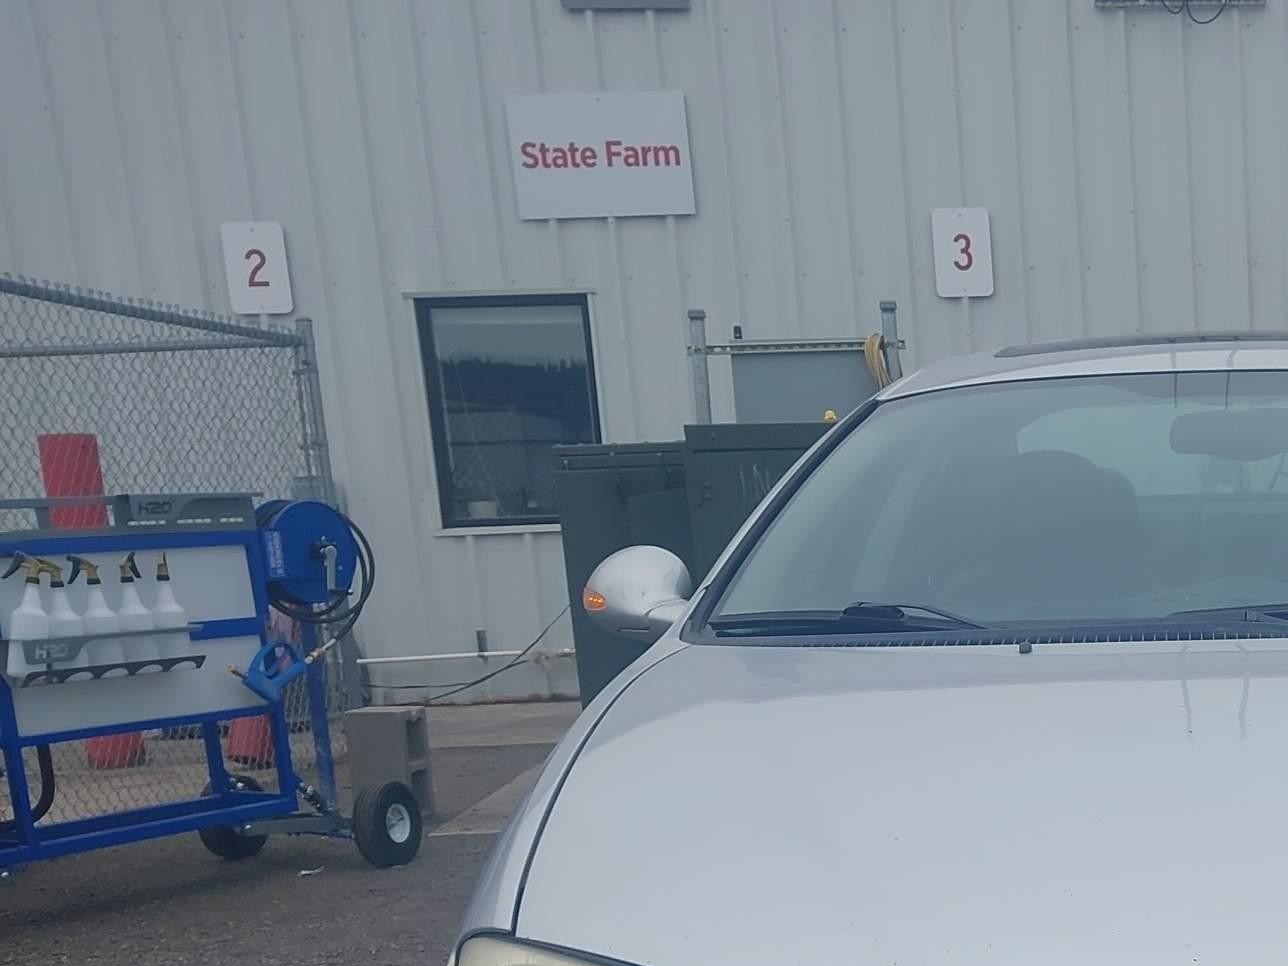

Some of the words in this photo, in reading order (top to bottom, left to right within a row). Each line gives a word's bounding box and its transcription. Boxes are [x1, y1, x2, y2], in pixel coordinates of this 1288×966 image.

[521, 141, 597, 169] State
[605, 140, 681, 168] Farm
[244, 248, 270, 287] 2
[953, 233, 973, 271] 3
